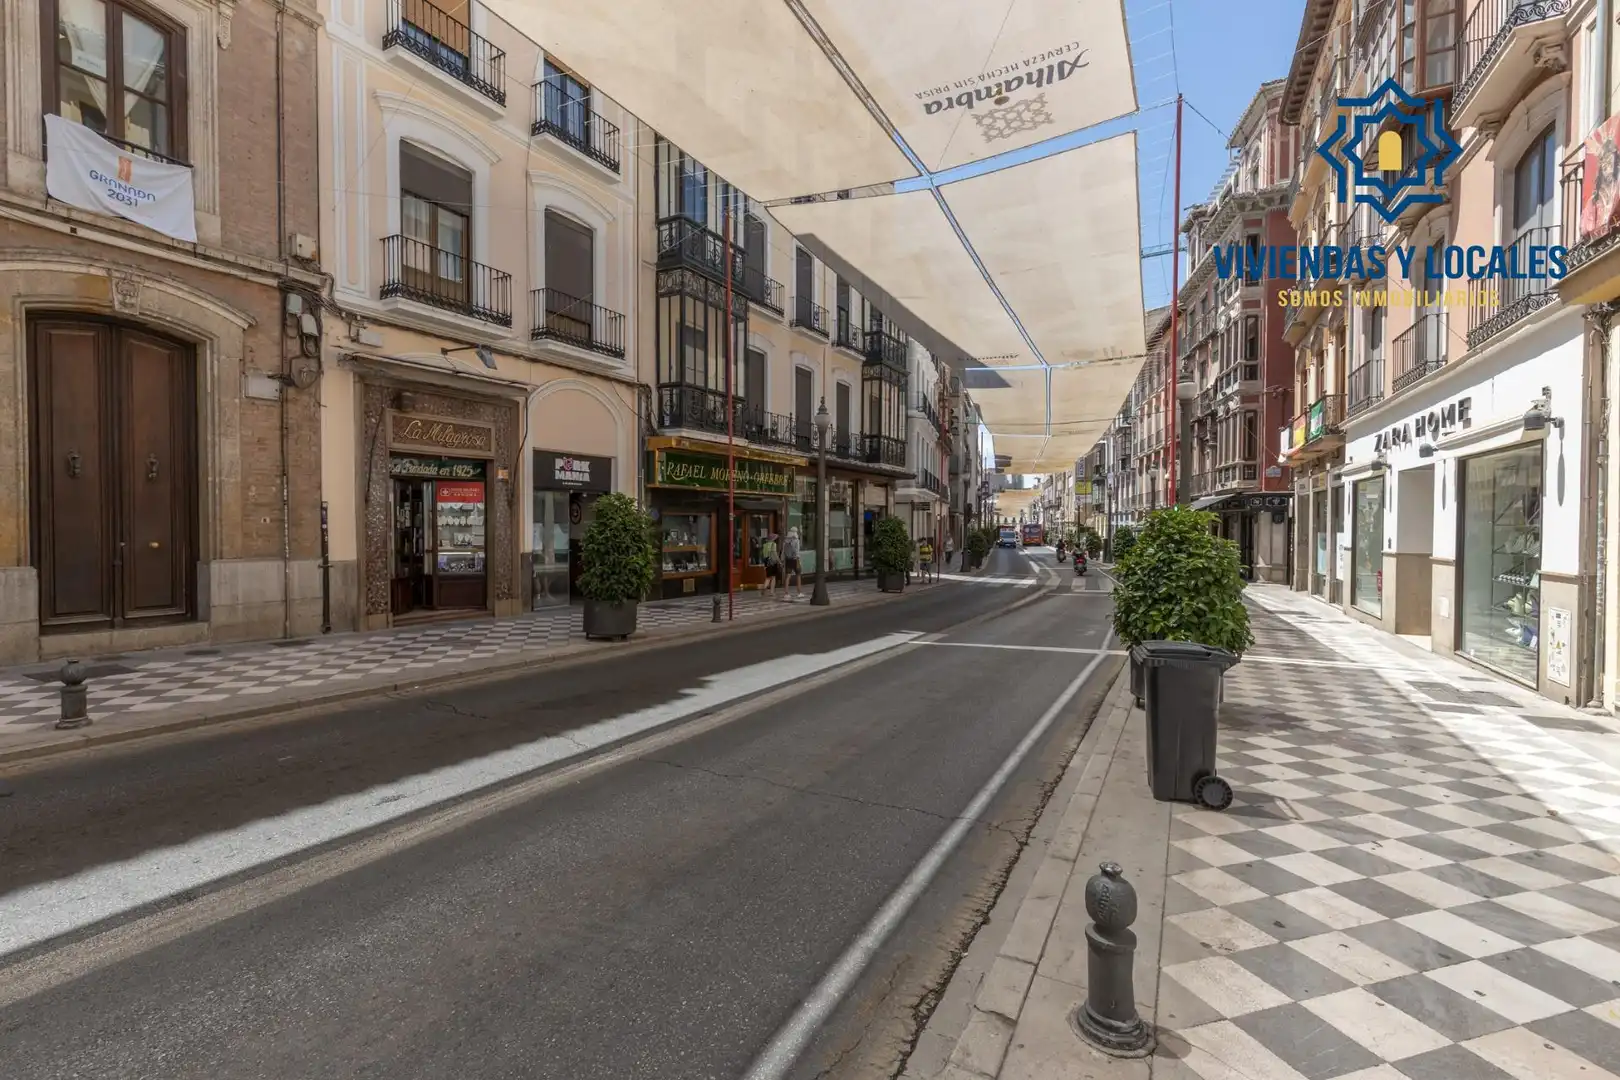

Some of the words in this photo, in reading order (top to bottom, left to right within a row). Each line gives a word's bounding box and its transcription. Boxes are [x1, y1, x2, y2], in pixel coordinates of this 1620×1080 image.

[1022, 41, 1080, 68] CERVEZA
[923, 49, 1090, 115] Alhambra
[954, 76, 975, 89] SIN
[978, 63, 1019, 82] HECHA
[915, 82, 950, 100] PRISA
[89, 169, 156, 202] GRANADA
[107, 188, 138, 207] 2031
[400, 420, 422, 440] La
[423, 423, 486, 448] Milagrosa
[1374, 423, 1413, 453] ZARA
[1415, 396, 1472, 438] HOME
[452, 464, 474, 477] 1925
[667, 461, 706, 481] RAFAEL
